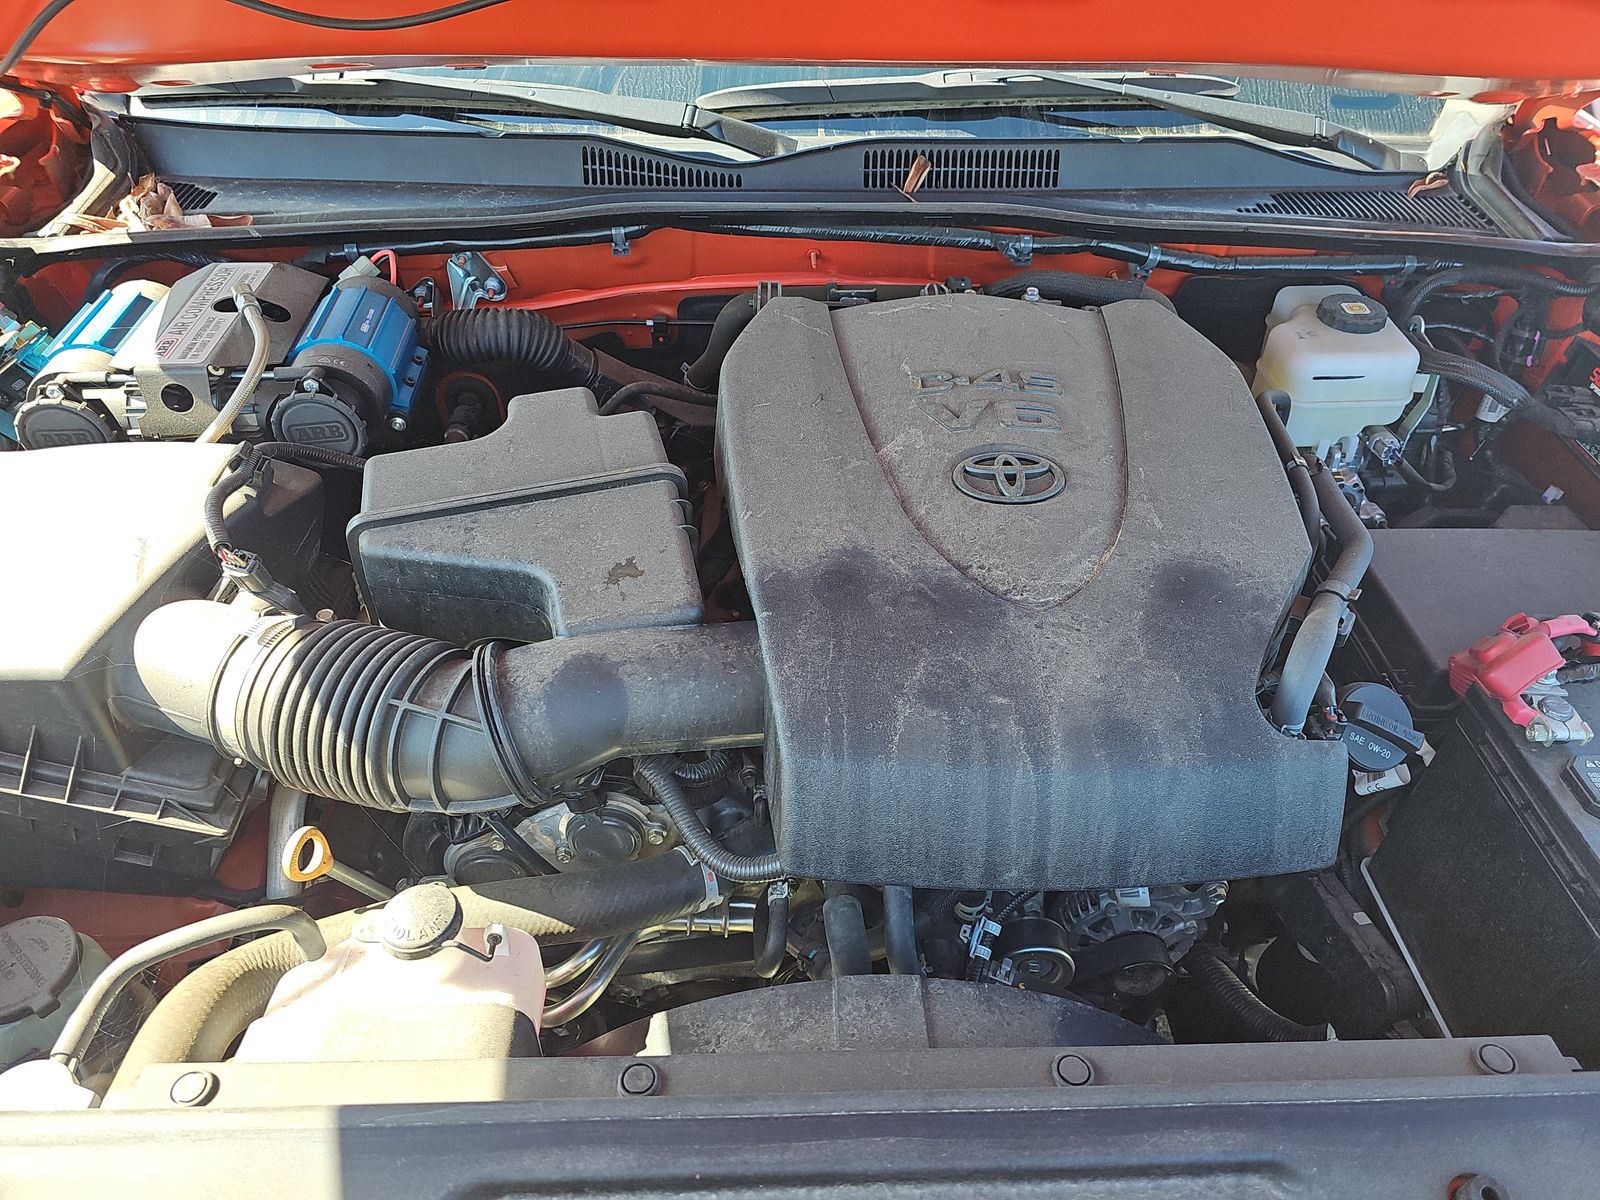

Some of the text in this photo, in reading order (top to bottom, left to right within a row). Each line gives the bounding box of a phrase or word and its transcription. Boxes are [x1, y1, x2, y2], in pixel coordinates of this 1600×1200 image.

[180, 267, 236, 320] COMPRESSOR
[168, 321, 193, 336] AIR
[913, 399, 1062, 434] V6
[297, 424, 344, 442] ARB
[1349, 731, 1392, 759] SAE 0W-20
[387, 913, 448, 941] OLANT
